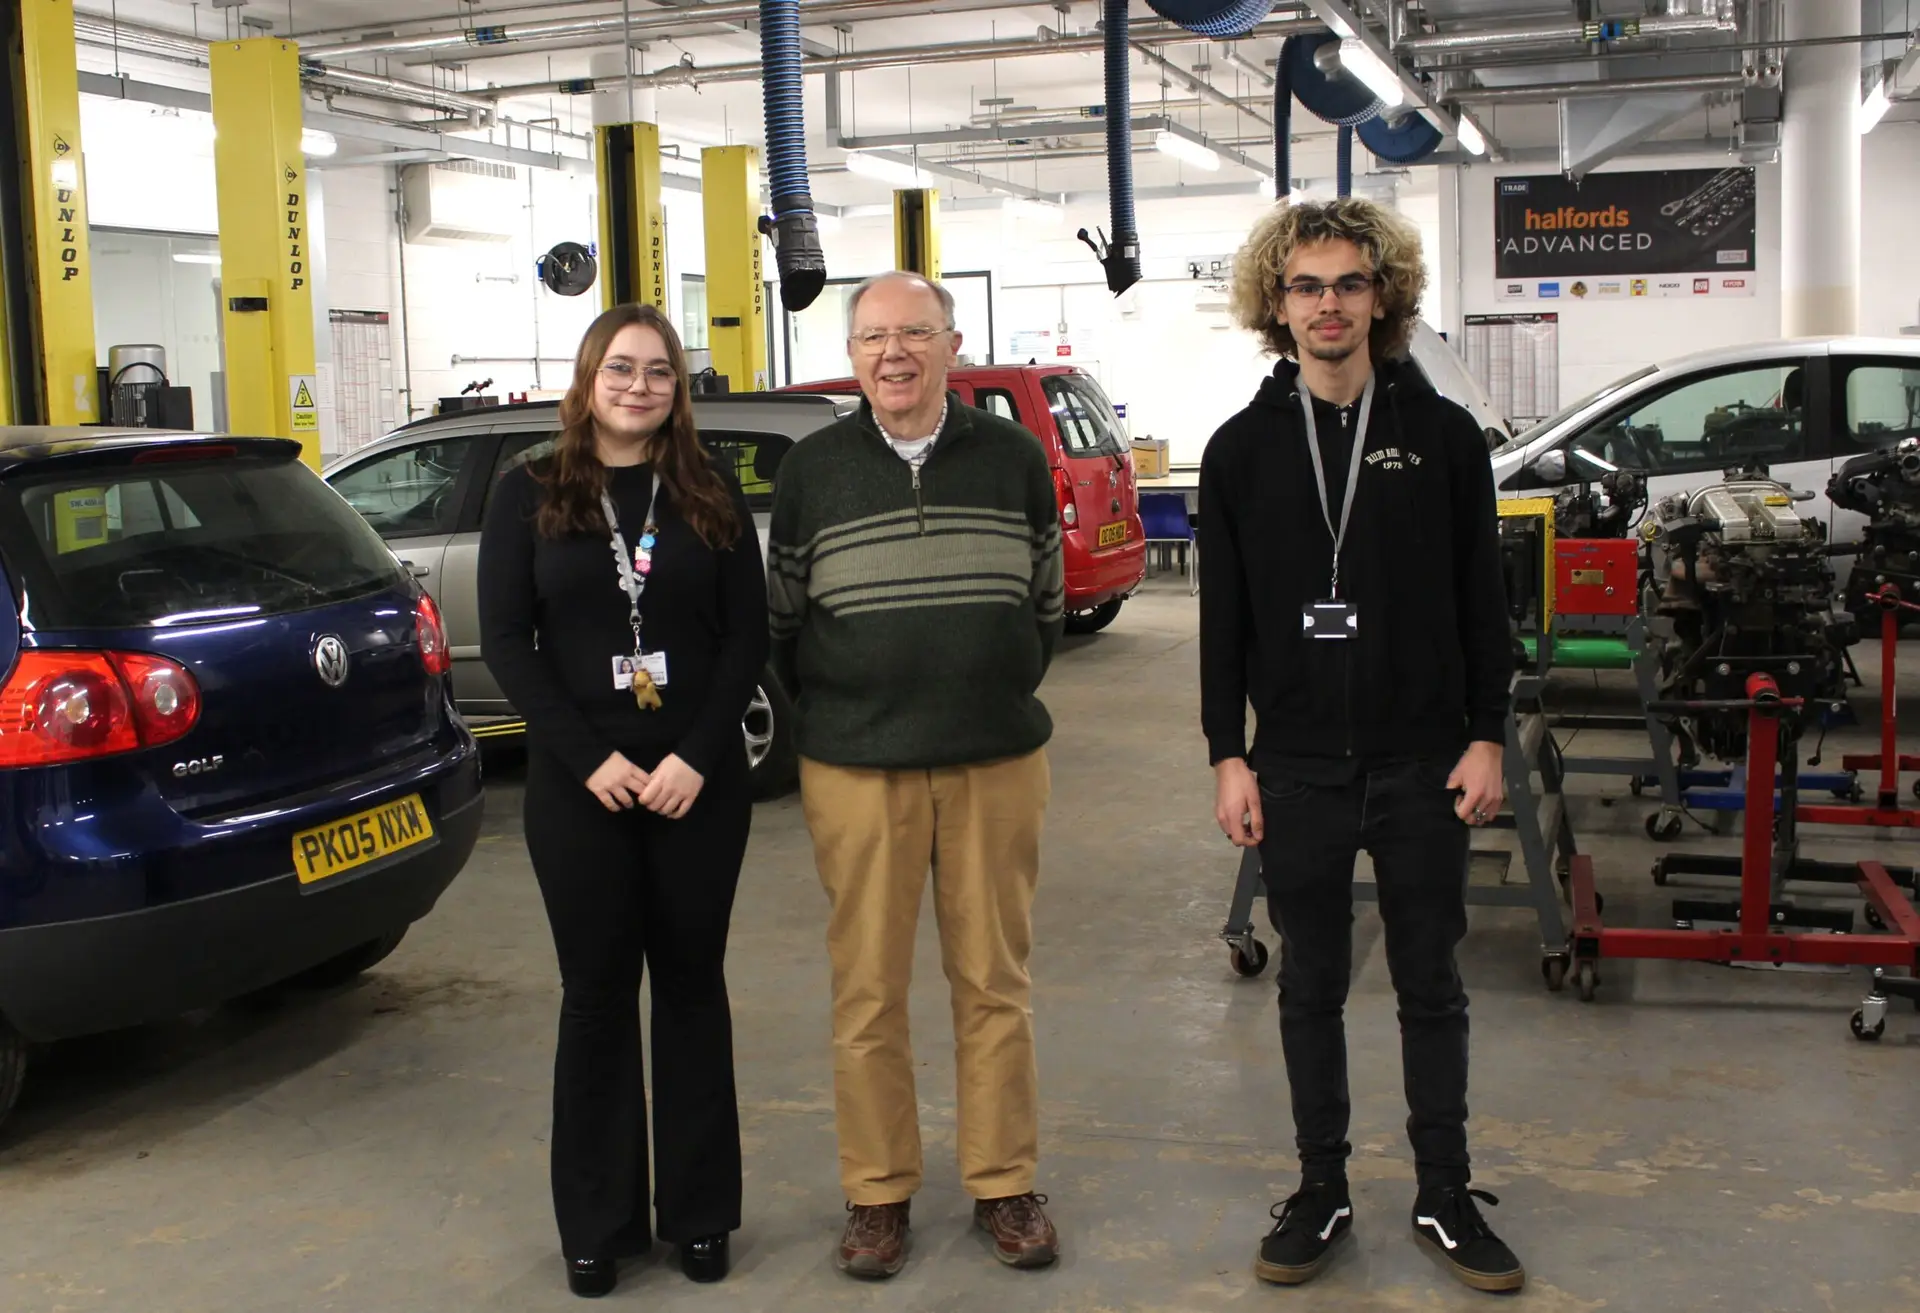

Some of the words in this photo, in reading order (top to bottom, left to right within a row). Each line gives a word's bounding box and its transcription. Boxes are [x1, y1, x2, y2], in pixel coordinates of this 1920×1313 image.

[1503, 184, 1527, 192] TRADE
[57, 171, 79, 281] UNLOP
[1525, 204, 1630, 230] halfords
[287, 193, 303, 290] DUNLOP
[1503, 232, 1652, 254] ADVANCED
[652, 237, 662, 308] DUNLOP
[753, 249, 762, 314] DUNLOP
[1383, 461, 1403, 469] 1978
[173, 755, 223, 777] GOLF
[300, 816, 376, 873] PK05
[377, 800, 423, 848] NXM
